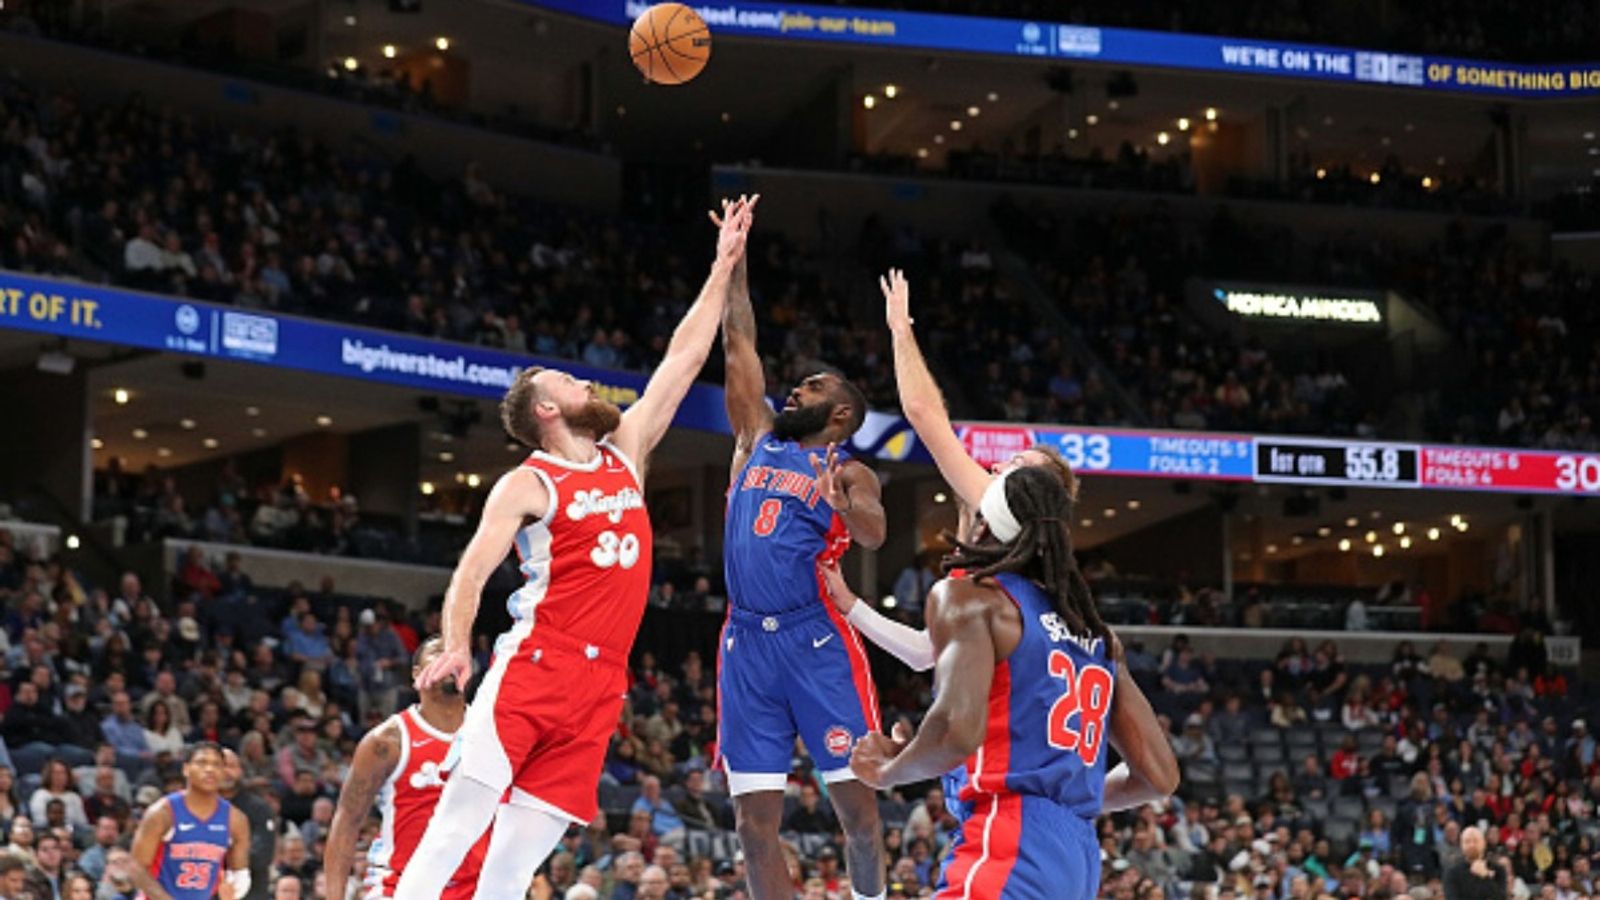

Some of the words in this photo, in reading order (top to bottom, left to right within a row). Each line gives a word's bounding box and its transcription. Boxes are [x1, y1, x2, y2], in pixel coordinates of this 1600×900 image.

[1222, 45, 1279, 68] WE'RE
[1282, 50, 1310, 71] ON
[1314, 53, 1350, 74] THE
[1355, 51, 1424, 85] EDGE
[1428, 63, 1452, 82] OF
[1456, 65, 1565, 90] SOMETHING
[1570, 70, 1600, 90] BIG
[28, 293, 65, 322] OF
[71, 299, 103, 328] IT.
[1060, 434, 1111, 469] 33
[1149, 437, 1235, 457] TIMEOUTS:
[1149, 455, 1204, 473] FOULS:
[1208, 458, 1219, 474] 2
[1346, 447, 1399, 480] 55.8
[1555, 455, 1600, 491] 30
[753, 498, 782, 537] 8
[590, 530, 640, 570] 30
[1047, 649, 1114, 767] 28
